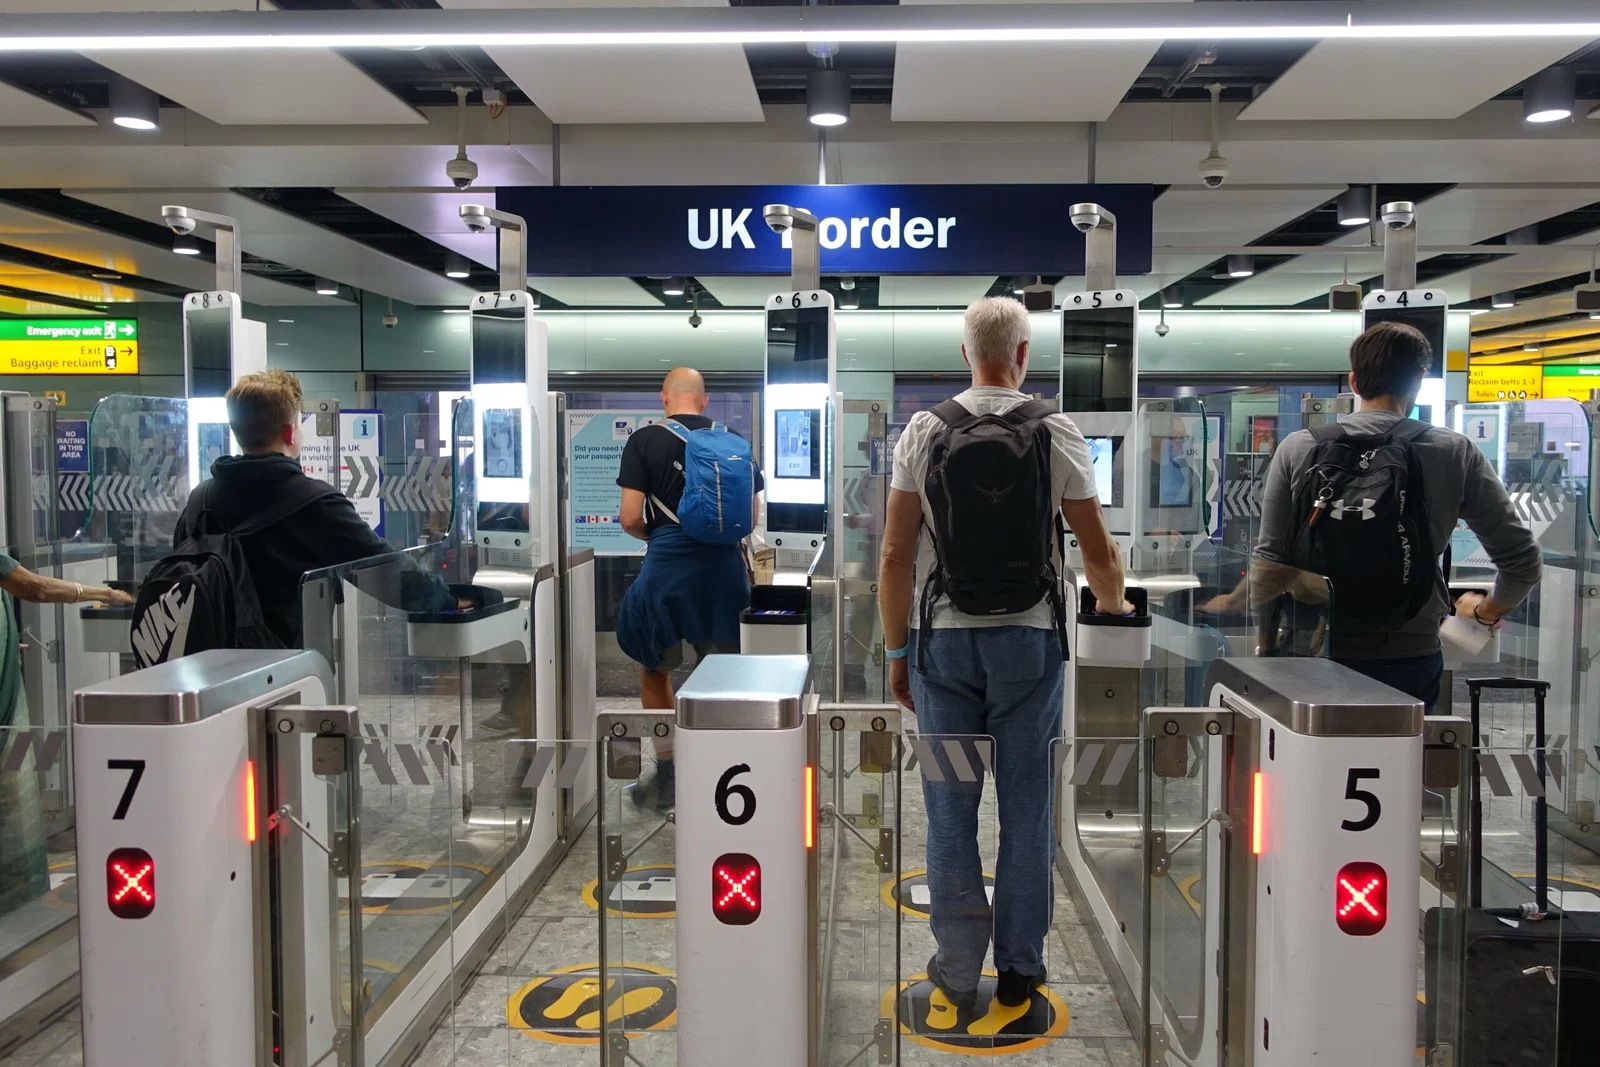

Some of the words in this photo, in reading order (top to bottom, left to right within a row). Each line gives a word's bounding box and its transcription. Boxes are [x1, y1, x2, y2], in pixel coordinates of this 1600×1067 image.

[688, 208, 756, 250] UK
[782, 207, 957, 249] order
[202, 293, 209, 309] 8
[493, 292, 500, 308] 7
[791, 292, 801, 308] 6
[1092, 291, 1102, 308] 5
[1396, 291, 1409, 307] 4
[26, 325, 81, 338] Emergency
[82, 325, 102, 336] exit
[80, 346, 101, 355] Exit
[10, 358, 59, 369] Baggage
[62, 358, 102, 367] reclaim
[301, 444, 320, 453] ming
[348, 444, 360, 452] UK
[131, 582, 183, 669] NIKE
[107, 759, 146, 820] 7
[715, 763, 757, 825] 6
[1341, 768, 1381, 831] 5
